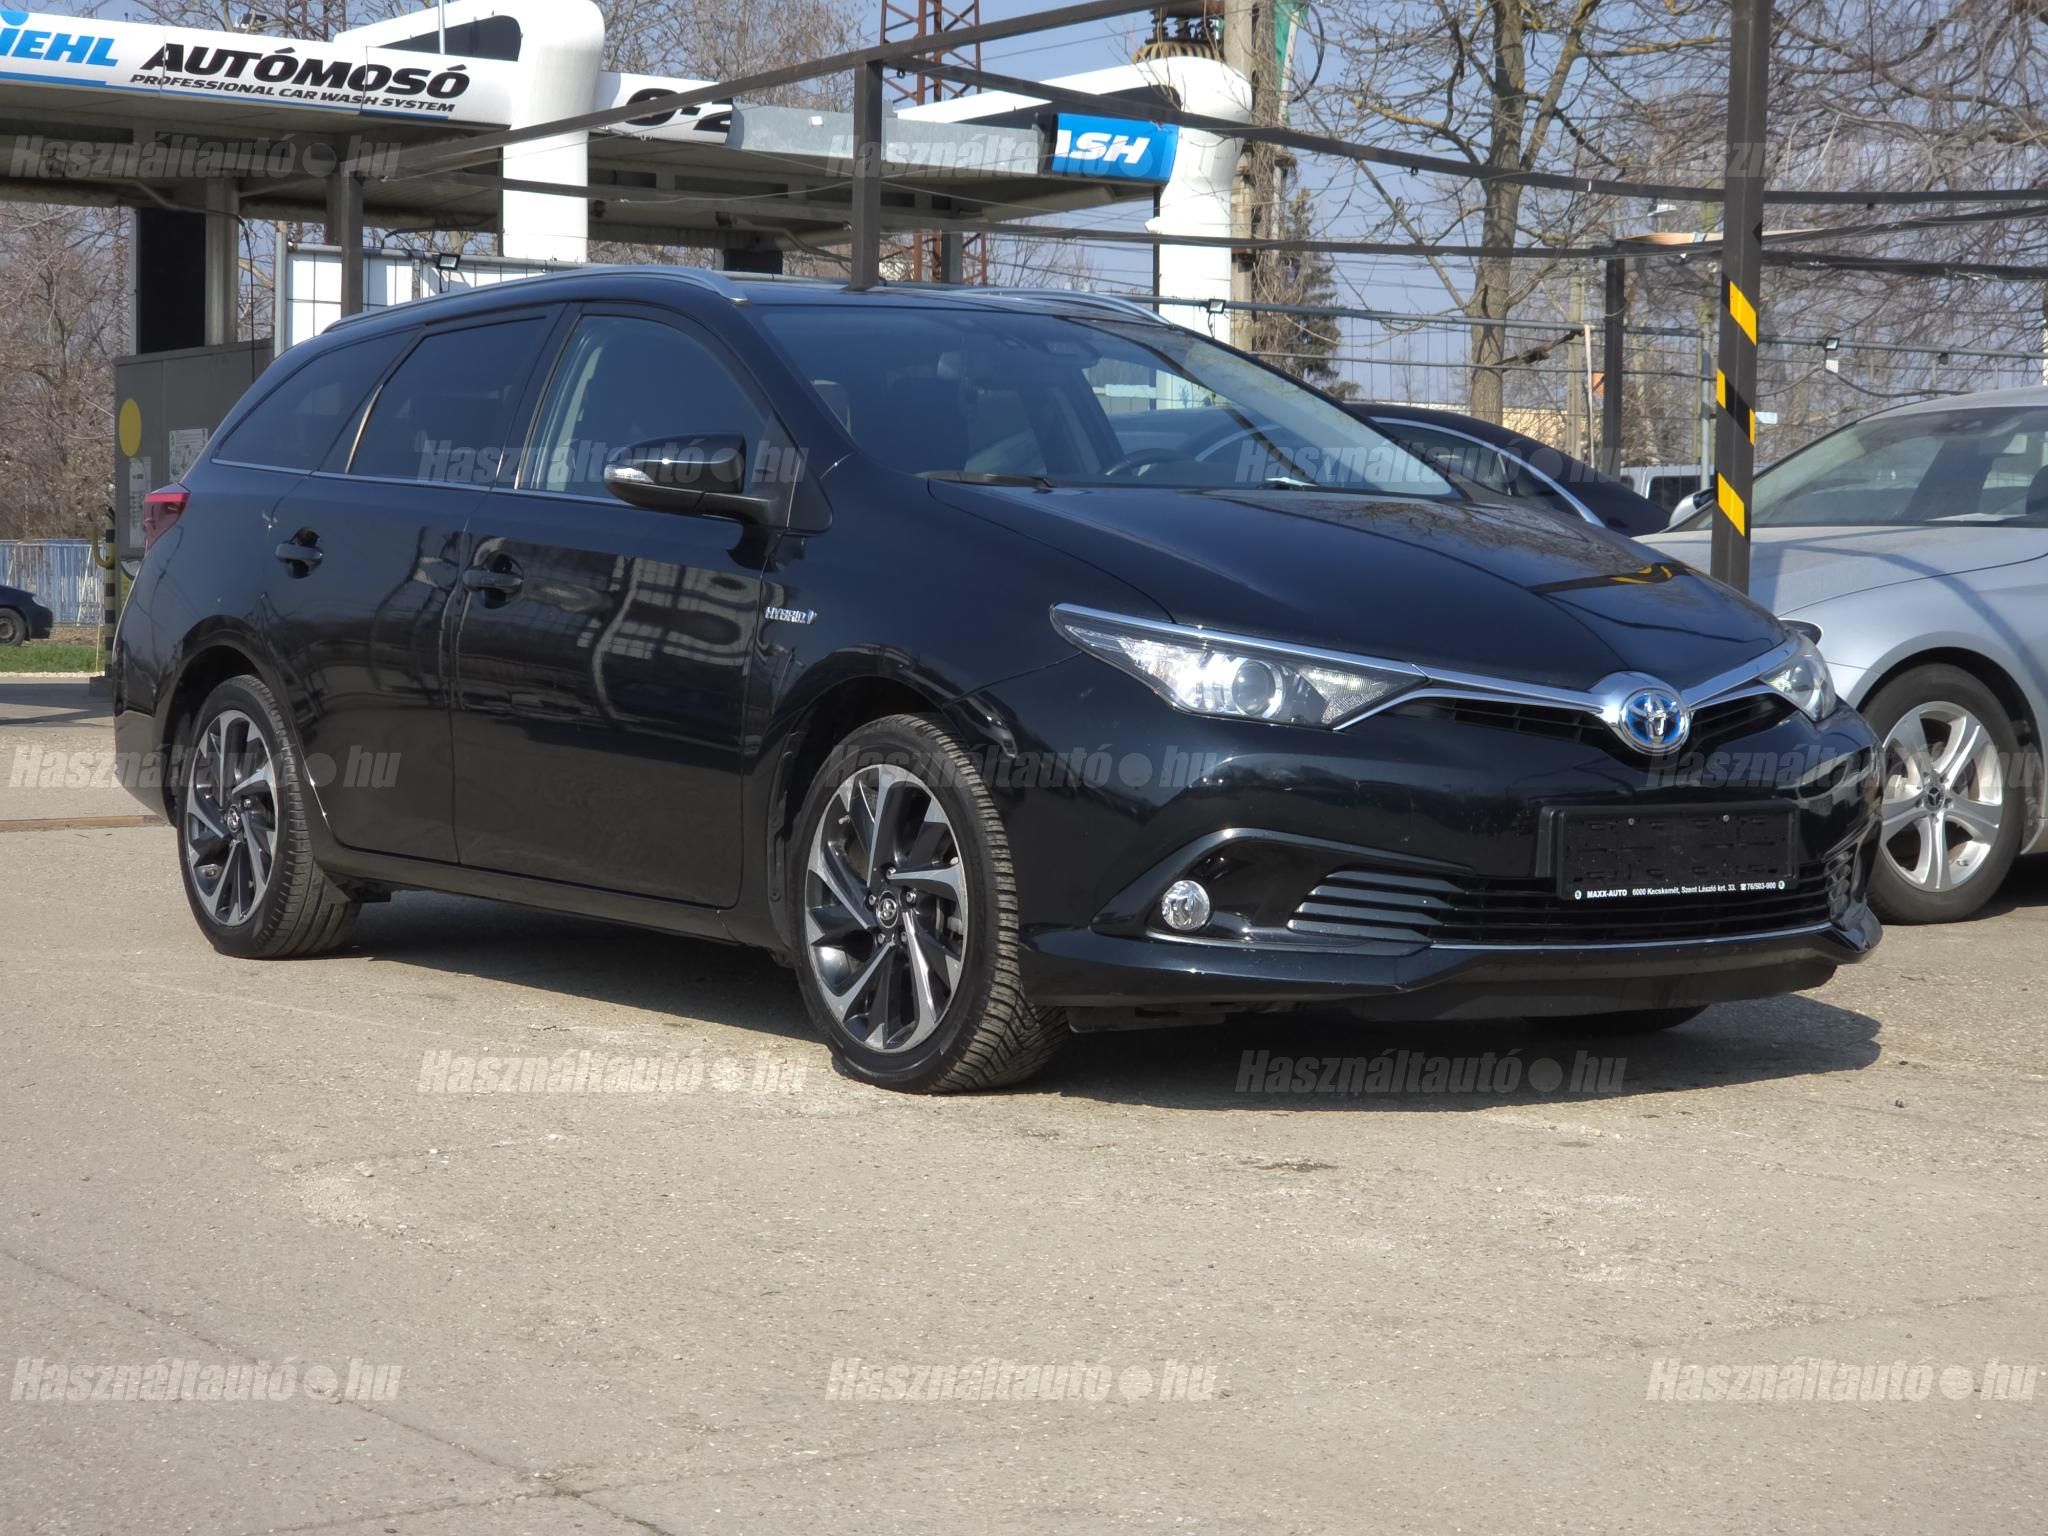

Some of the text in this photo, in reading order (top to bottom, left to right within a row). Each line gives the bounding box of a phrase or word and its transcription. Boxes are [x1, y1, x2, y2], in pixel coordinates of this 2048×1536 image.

[140, 43, 470, 99] AUTÓMOSÓ
[130, 74, 456, 113] PROFESSIONAL CAR WASH SYSTEM
[765, 606, 806, 624] HYBRID
[1586, 889, 1628, 899] MAXX-AUTO
